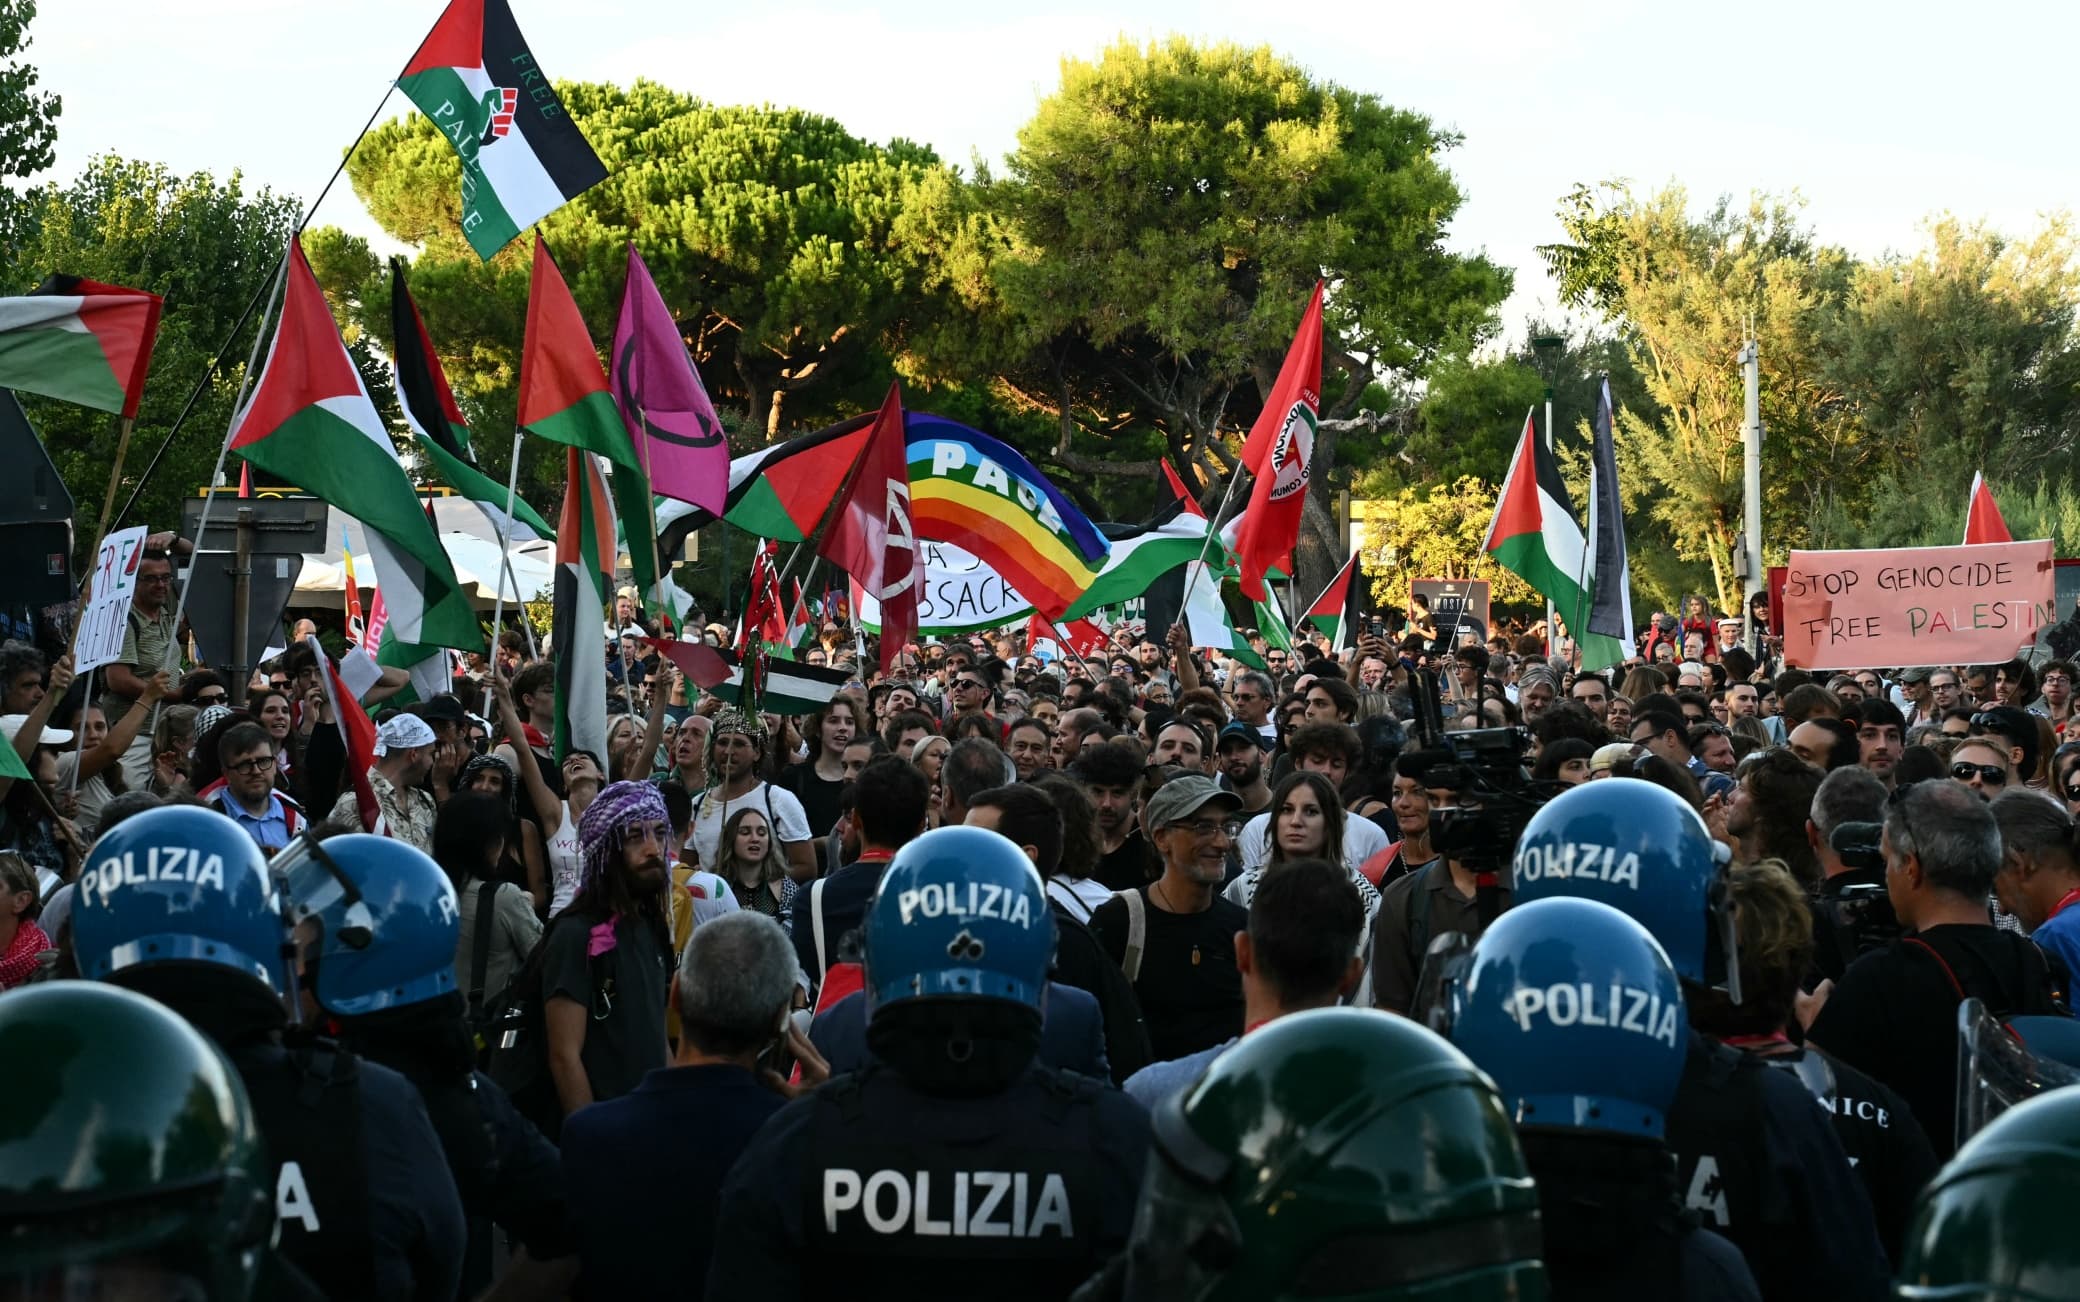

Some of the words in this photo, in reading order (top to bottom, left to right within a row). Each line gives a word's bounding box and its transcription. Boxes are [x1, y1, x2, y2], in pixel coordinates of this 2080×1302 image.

[511, 52, 562, 120] FREE
[1788, 570, 1859, 597] STOP
[1877, 562, 2013, 592] GENOCIDE
[1799, 616, 1881, 647] FREE
[80, 846, 224, 908] POLIZIA
[1512, 842, 1640, 891] POLIZIA
[898, 881, 1030, 930] POLIZIA
[1513, 982, 1678, 1048] POLIZIA
[1816, 1096, 1890, 1129] NICE
[275, 1160, 321, 1233] A
[823, 1168, 1074, 1238] POLIZIA
[1685, 1155, 1731, 1227] A
